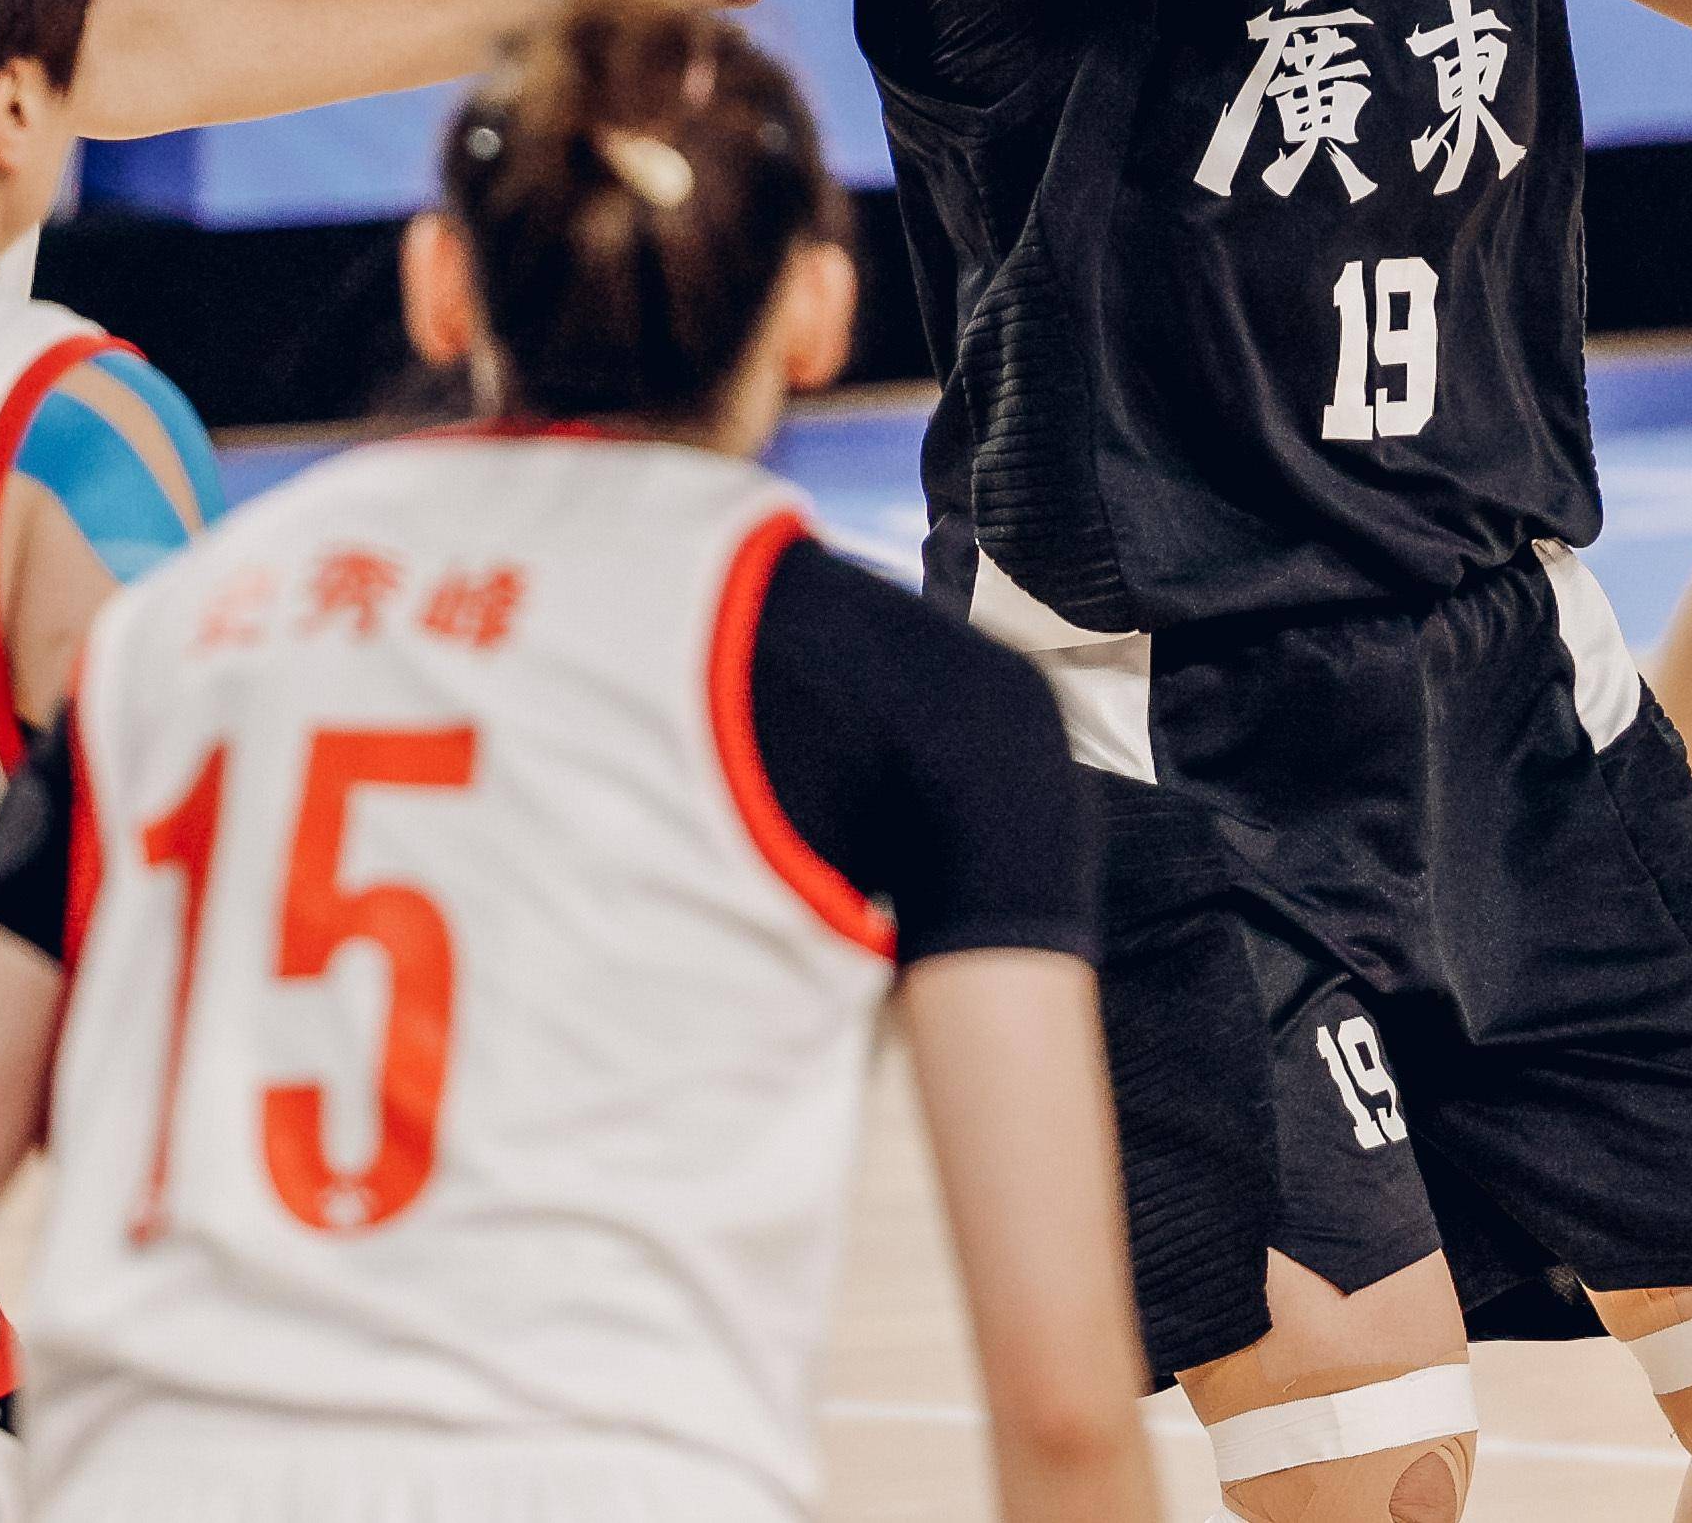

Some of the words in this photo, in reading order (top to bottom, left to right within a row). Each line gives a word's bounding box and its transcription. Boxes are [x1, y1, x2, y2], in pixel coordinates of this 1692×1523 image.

[1321, 257, 1440, 441] 19
[123, 721, 484, 1250] 15
[1316, 1016, 1409, 1150] 19
